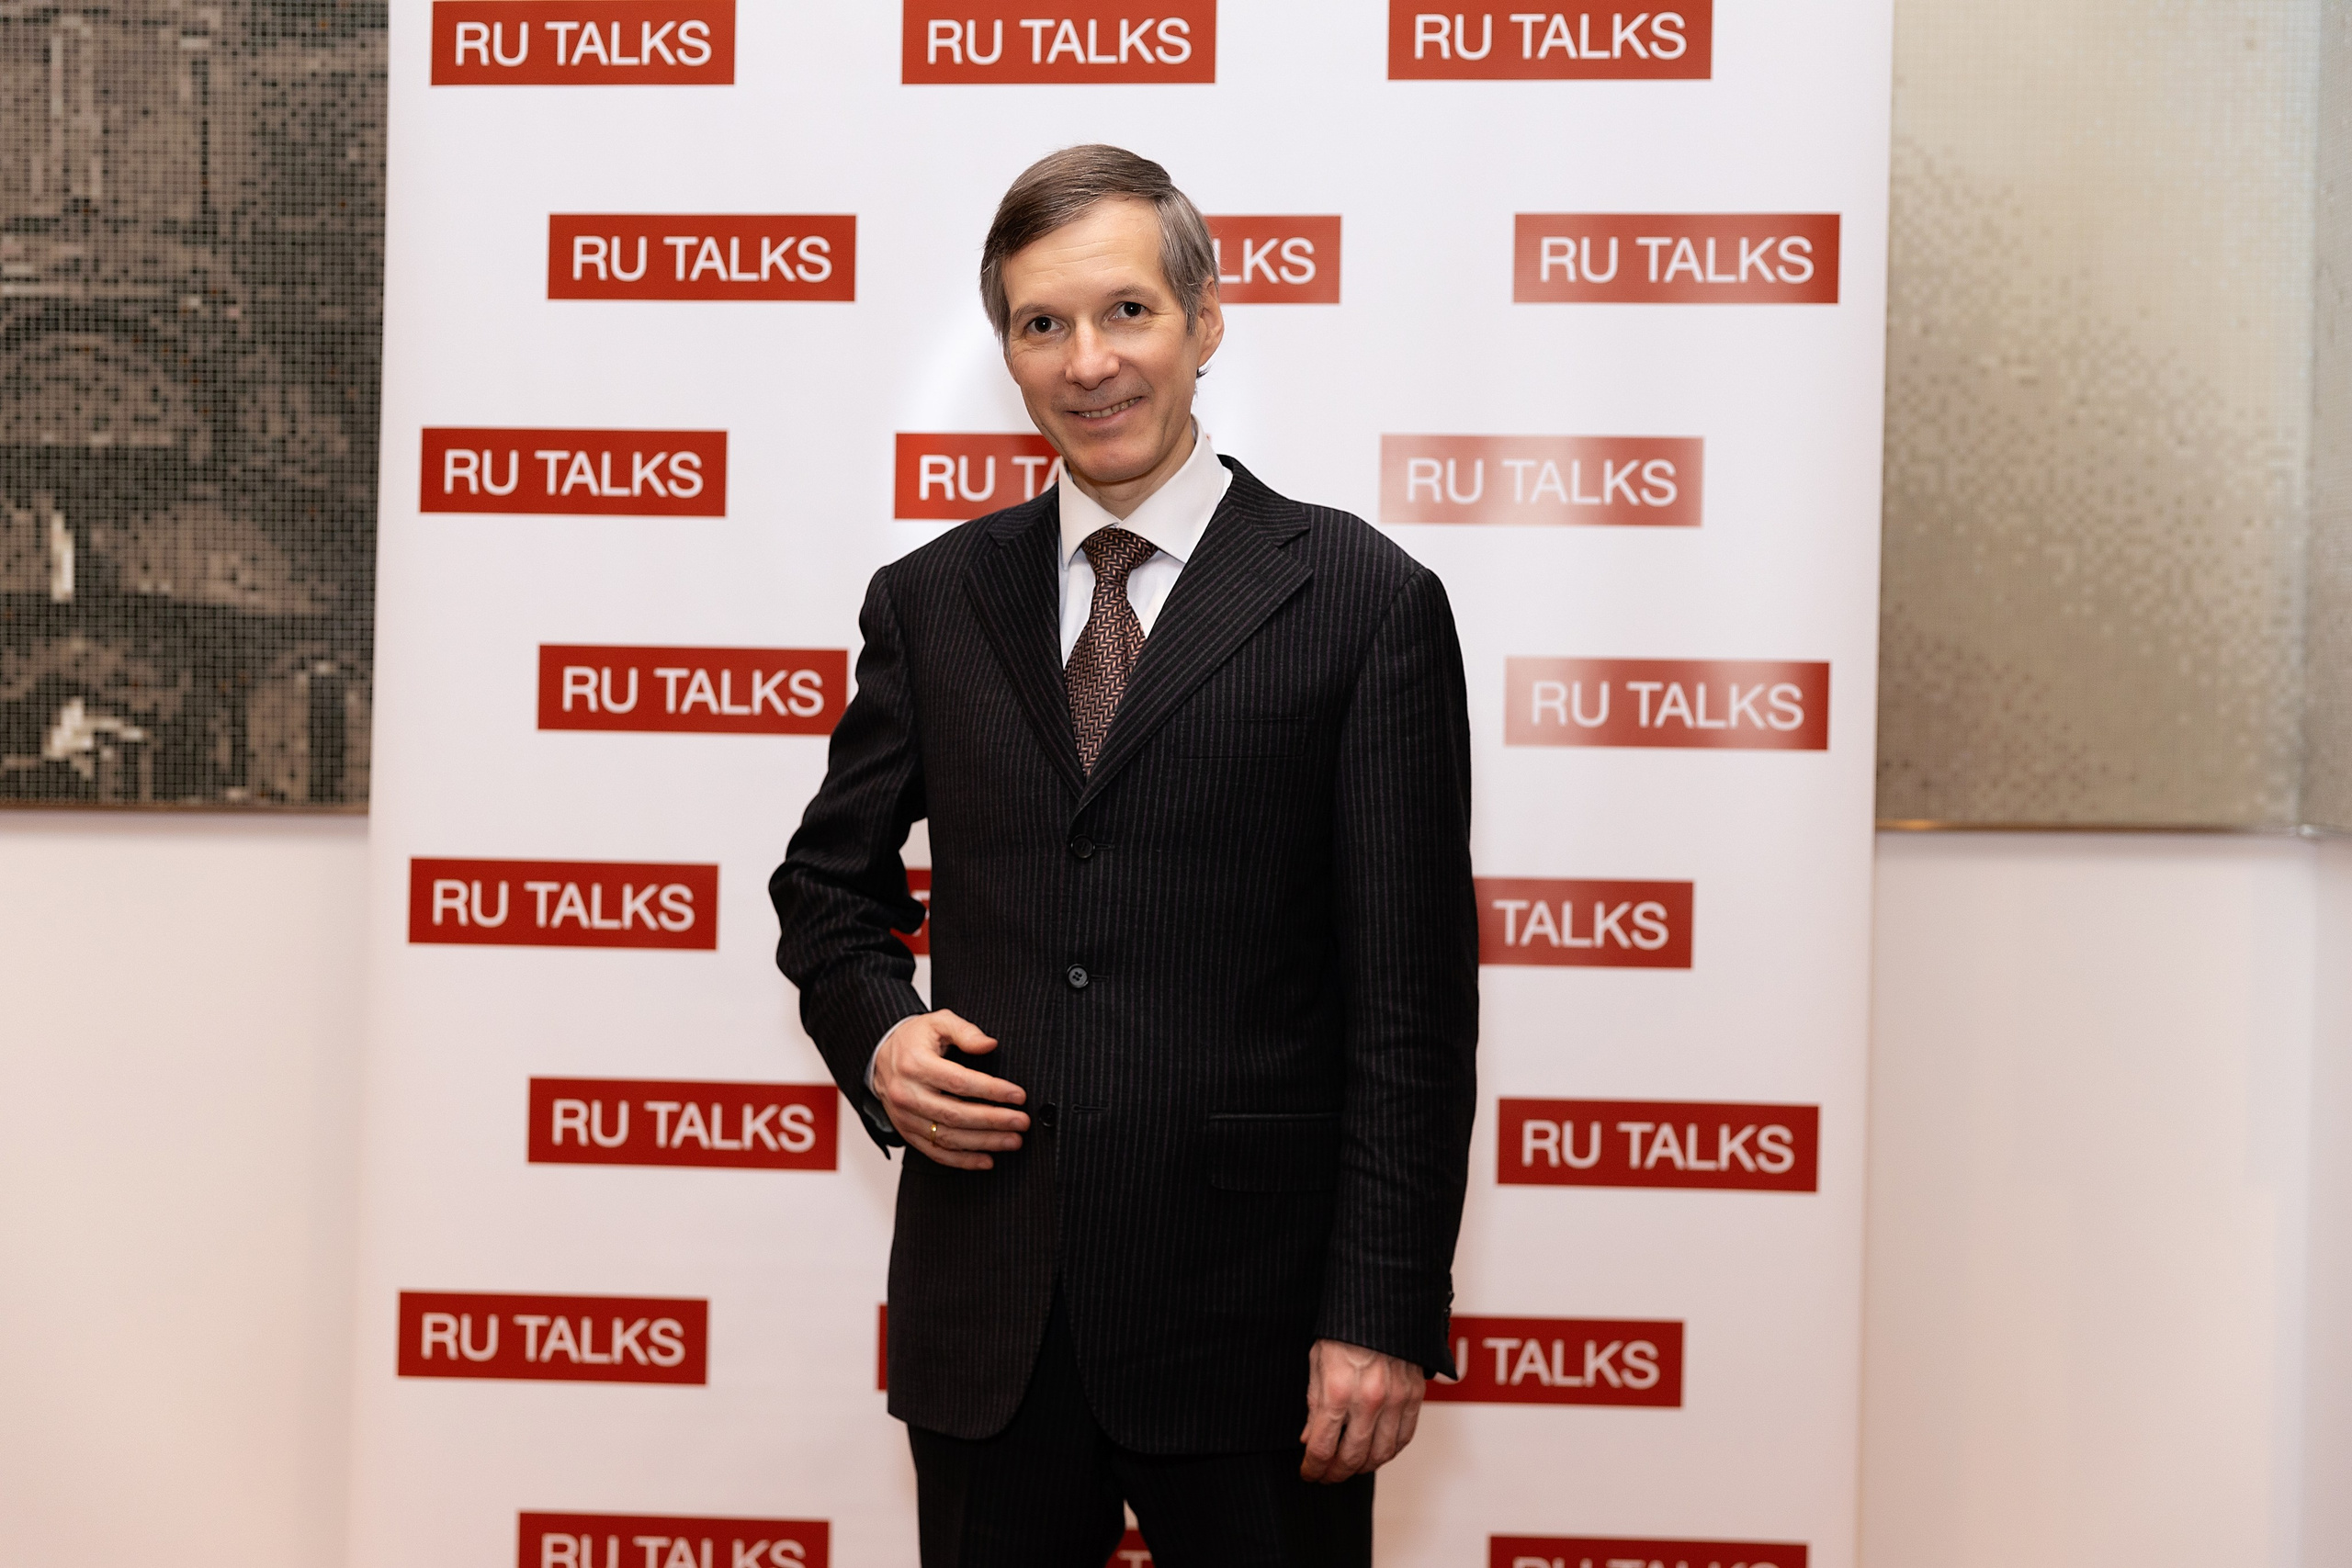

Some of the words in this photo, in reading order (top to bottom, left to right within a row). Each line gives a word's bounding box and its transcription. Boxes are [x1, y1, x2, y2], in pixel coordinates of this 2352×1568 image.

[455, 21, 529, 67] RU
[545, 20, 712, 66] TALKS
[927, 19, 1003, 64] RU
[1019, 17, 1192, 64] TALKS
[1414, 14, 1493, 61] RU
[1510, 13, 1687, 60] TALKS
[572, 235, 648, 282] RU
[662, 235, 832, 283] TALKS
[1211, 237, 1317, 285] LKS
[1539, 236, 1619, 284] RU
[1635, 235, 1814, 284] TALKS
[444, 448, 519, 496] RU
[535, 450, 704, 499] TALKS
[919, 455, 996, 502] RU
[1407, 457, 1485, 505] RU
[1501, 458, 1678, 507] TALKS
[562, 666, 639, 714] RU
[653, 668, 824, 717] TALKS
[1531, 681, 1610, 728] RU
[1626, 681, 1805, 731] TALKS
[432, 879, 509, 928] RU
[524, 881, 695, 931] TALKS
[1491, 898, 1669, 950] TALKS
[552, 1099, 629, 1147] RU
[644, 1100, 816, 1153] TALKS
[1521, 1120, 1601, 1168] RU
[1617, 1122, 1795, 1174] TALKS
[421, 1312, 499, 1361] RU
[513, 1314, 685, 1367] TALKS
[1482, 1337, 1660, 1390] TALKS
[540, 1532, 620, 1568] RU
